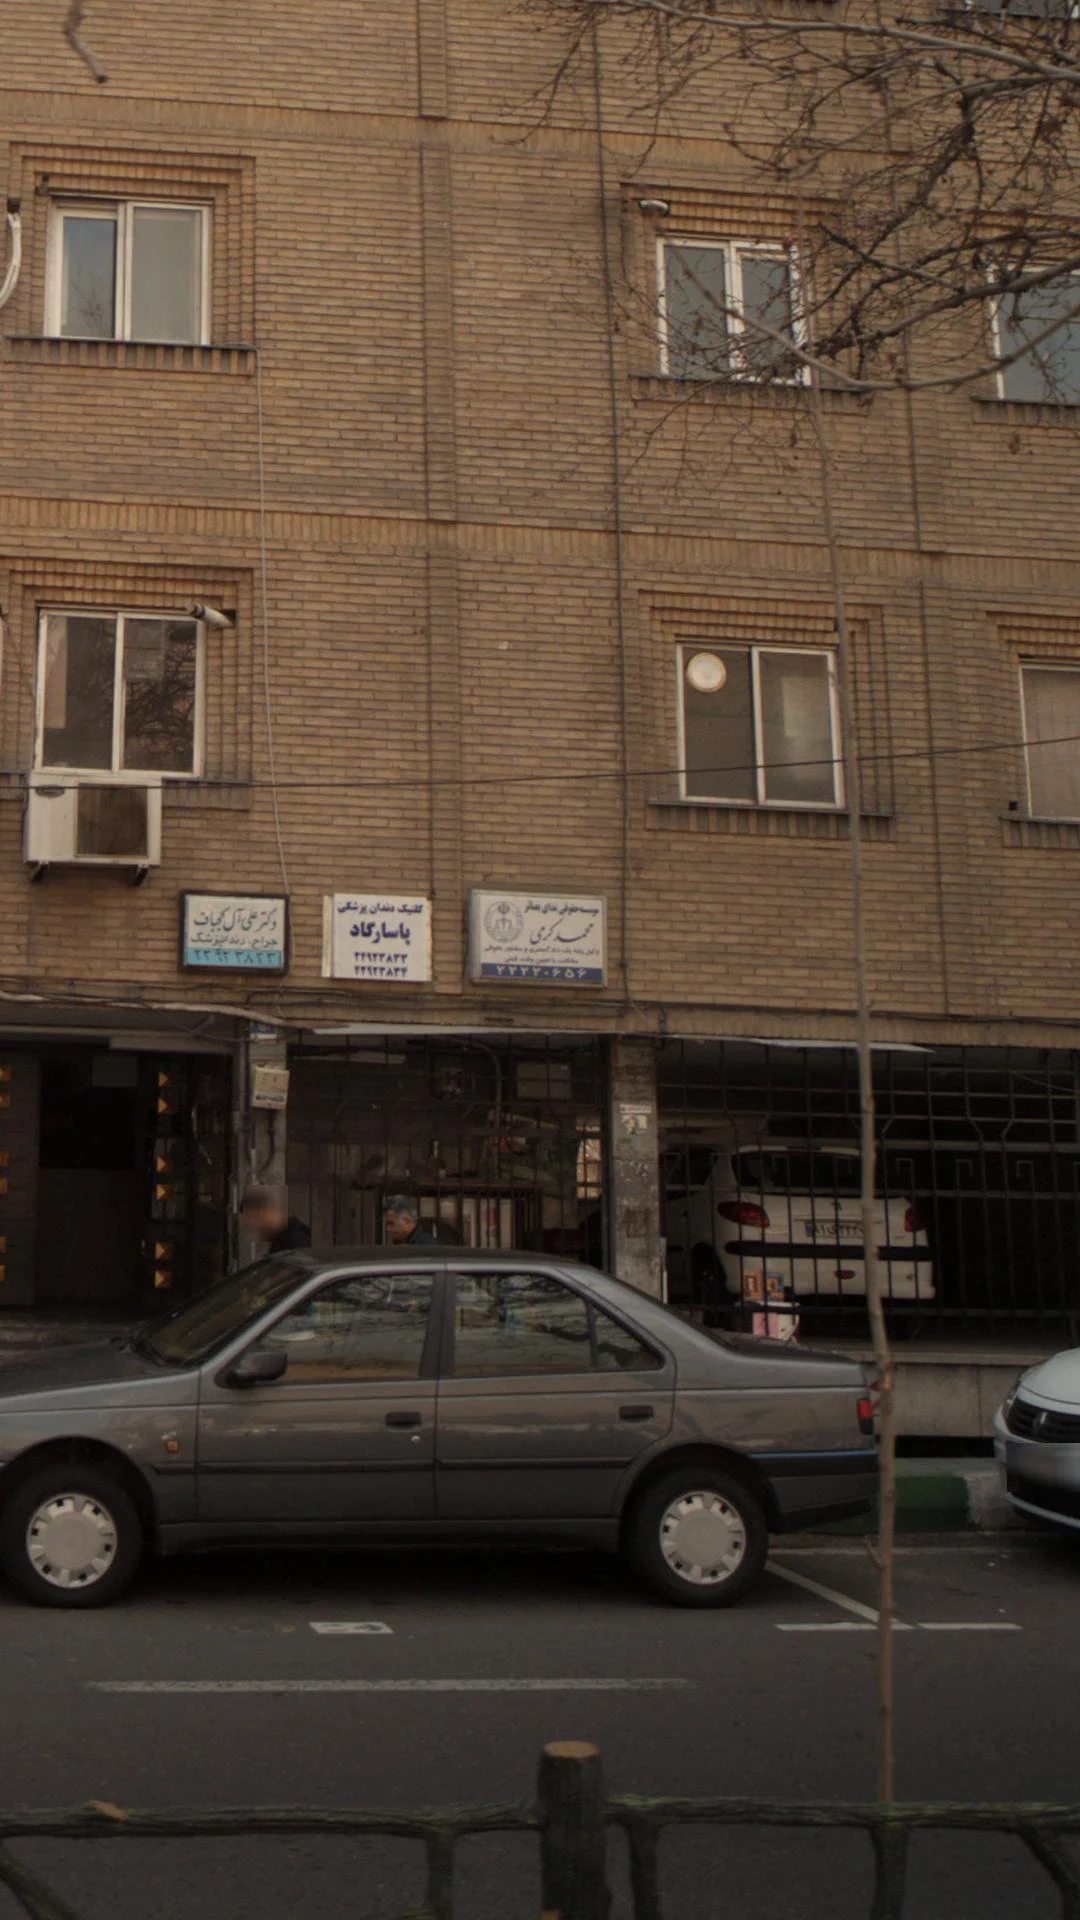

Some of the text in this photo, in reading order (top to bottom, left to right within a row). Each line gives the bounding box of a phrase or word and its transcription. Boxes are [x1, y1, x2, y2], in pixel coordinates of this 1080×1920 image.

[241, 911, 258, 931] علی
[256, 907, 278, 932] دکتر
[350, 921, 411, 945] پاسارگاد
[553, 922, 594, 943] محمد
